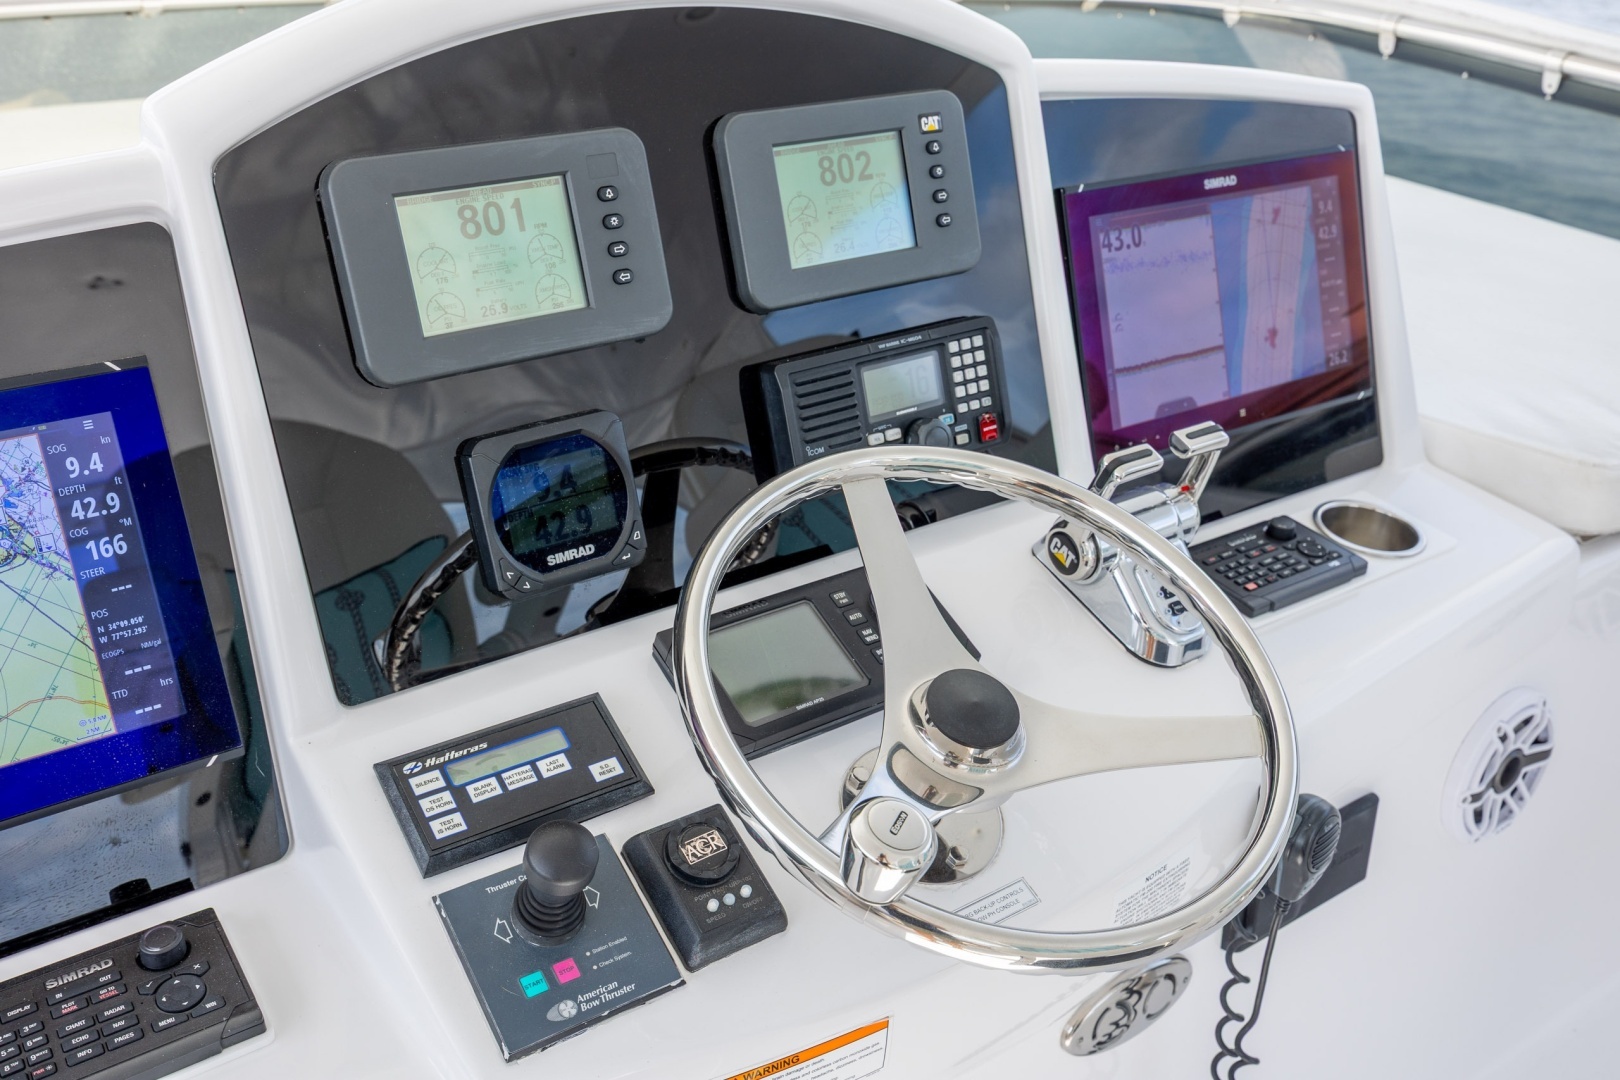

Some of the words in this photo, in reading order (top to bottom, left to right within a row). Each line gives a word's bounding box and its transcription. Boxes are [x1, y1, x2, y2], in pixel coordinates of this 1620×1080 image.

[920, 115, 939, 132] CAT
[818, 150, 874, 187] 802
[1203, 174, 1238, 190] SIMRAD
[458, 198, 526, 240] 801
[1101, 224, 1143, 253] 43.0
[480, 302, 508, 318] 26.9
[100, 436, 111, 444] kn
[46, 444, 67, 455] SOG
[66, 452, 104, 479] 9.4
[114, 476, 123, 485] ft
[58, 484, 86, 496] DEPTH
[71, 492, 120, 520] 42.9
[535, 504, 593, 545] 42.9
[69, 527, 89, 538] COG
[85, 533, 128, 560] 166
[546, 544, 596, 566] SIMRAD
[1050, 537, 1079, 570] CAT
[80, 566, 106, 580] STEER
[91, 608, 109, 620] POS
[849, 612, 863, 620] AUTO
[862, 628, 873, 636] NAV
[864, 634, 879, 642] WIND
[99, 636, 108, 644] W
[140, 638, 162, 648] NM/gal
[102, 648, 124, 660] ECOGPS
[160, 677, 174, 686] hrs
[112, 688, 128, 700] TTD
[424, 742, 488, 768] Hatteras
[546, 758, 560, 766] LAST
[546, 763, 566, 772] ALARM
[504, 768, 533, 781] HATTERAS
[598, 767, 617, 777] RESET
[415, 776, 441, 788] SILENCE
[507, 774, 535, 786] MESSAGE
[473, 782, 494, 792] BLANK
[474, 786, 498, 798] DISPLAY
[429, 796, 444, 804] TEST
[436, 800, 454, 810] HORN
[438, 826, 444, 834] IS
[446, 821, 463, 831] HORN
[439, 818, 454, 826] TEST
[684, 833, 725, 861] ACR
[1145, 864, 1168, 883] NOTICE
[485, 878, 517, 894] Thruster
[974, 900, 996, 915] BACK-UP
[996, 887, 1024, 904] CONTROLS
[996, 898, 1020, 912] CONSOLE
[706, 912, 726, 924] SPEED
[592, 944, 608, 954] Station
[608, 936, 628, 948] Enabled
[599, 958, 614, 968] Check
[614, 951, 632, 961] System
[46, 958, 114, 990] SIMRAD
[558, 965, 574, 976] STOP
[99, 974, 112, 982] OUT
[524, 978, 544, 990] START
[98, 990, 118, 1000] VESSEL
[577, 982, 618, 1004] American
[580, 1000, 600, 1012] Bow
[600, 983, 636, 1002] Thruster
[7, 1004, 31, 1016] DISPLAY
[61, 1004, 78, 1014] MARK
[104, 1004, 126, 1016] RADAR
[66, 1020, 86, 1031] CHART
[112, 1020, 125, 1028] NAV
[158, 1016, 176, 1027] MENU
[72, 1034, 90, 1044] ECHO
[114, 1032, 135, 1044] PAGES
[77, 1048, 92, 1058] INFO
[744, 1056, 800, 1080] WARNING
